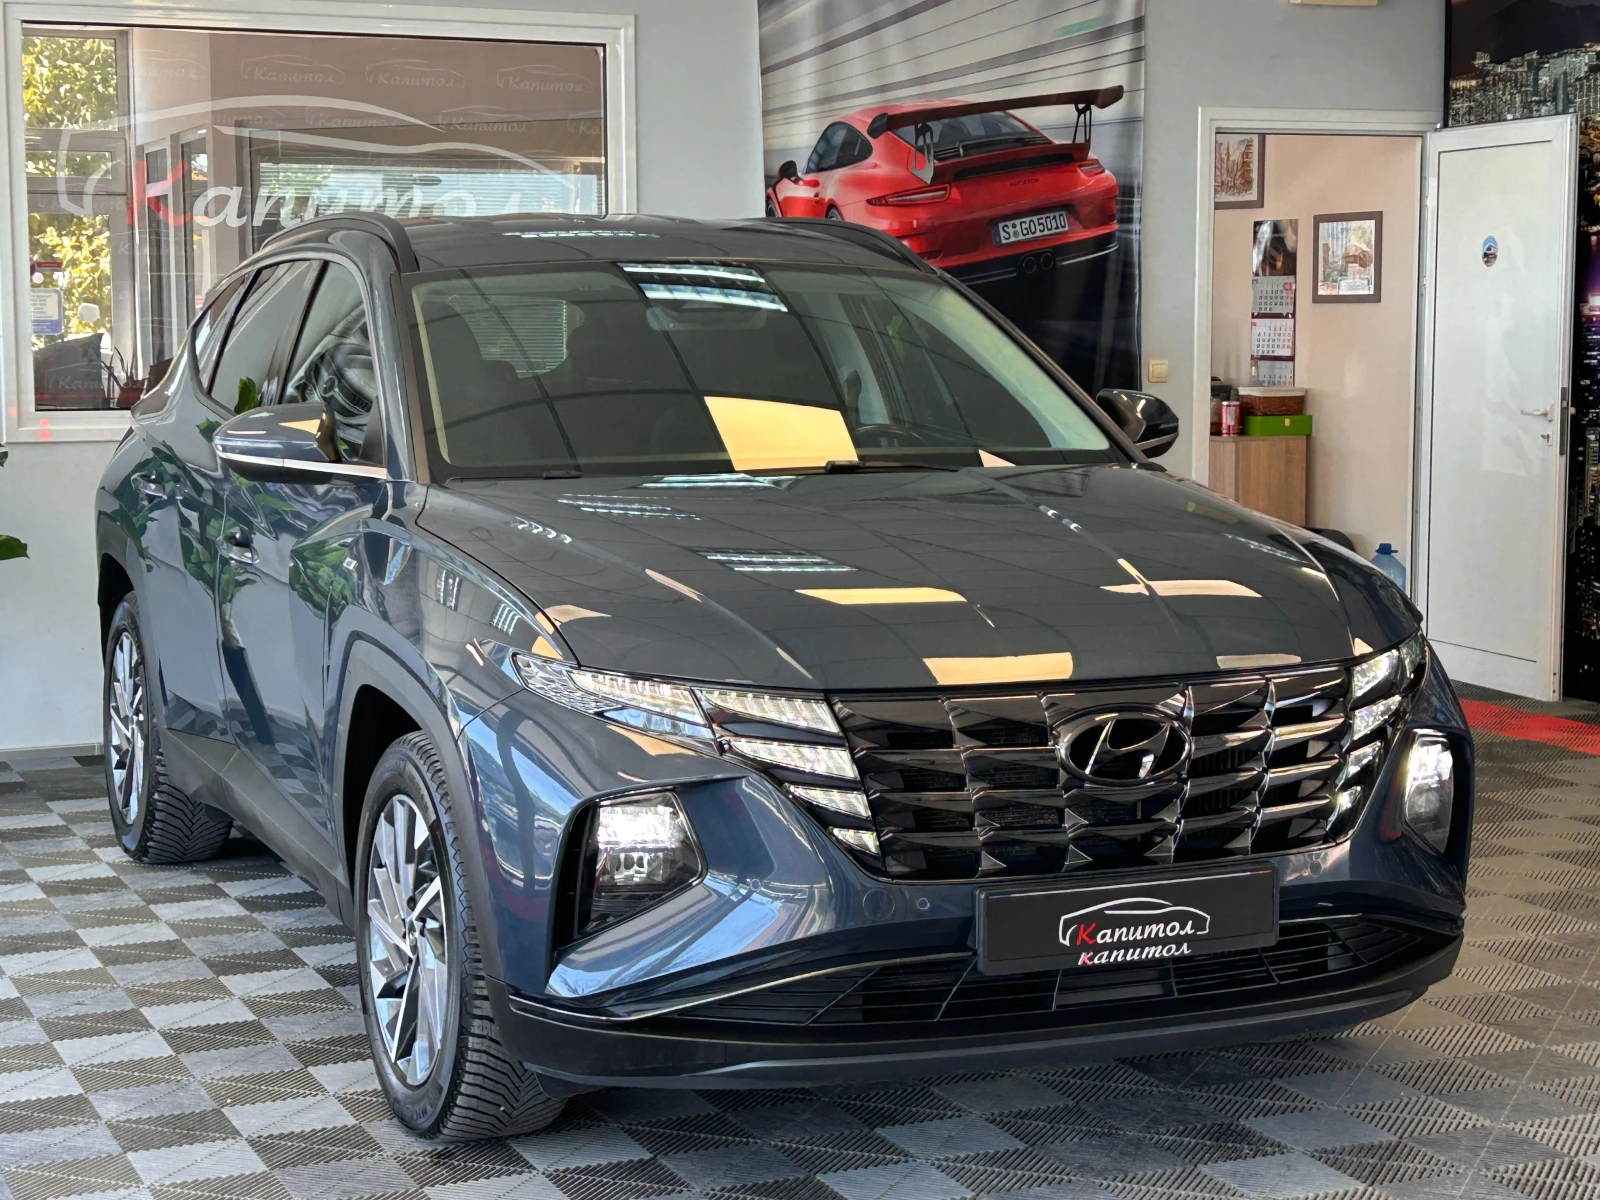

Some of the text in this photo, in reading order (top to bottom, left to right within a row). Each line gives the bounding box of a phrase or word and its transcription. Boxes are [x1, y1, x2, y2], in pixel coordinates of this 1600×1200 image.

[250, 66, 336, 84] Капитол
[377, 71, 455, 88] Капитол
[1076, 919, 1195, 946] Капитол
